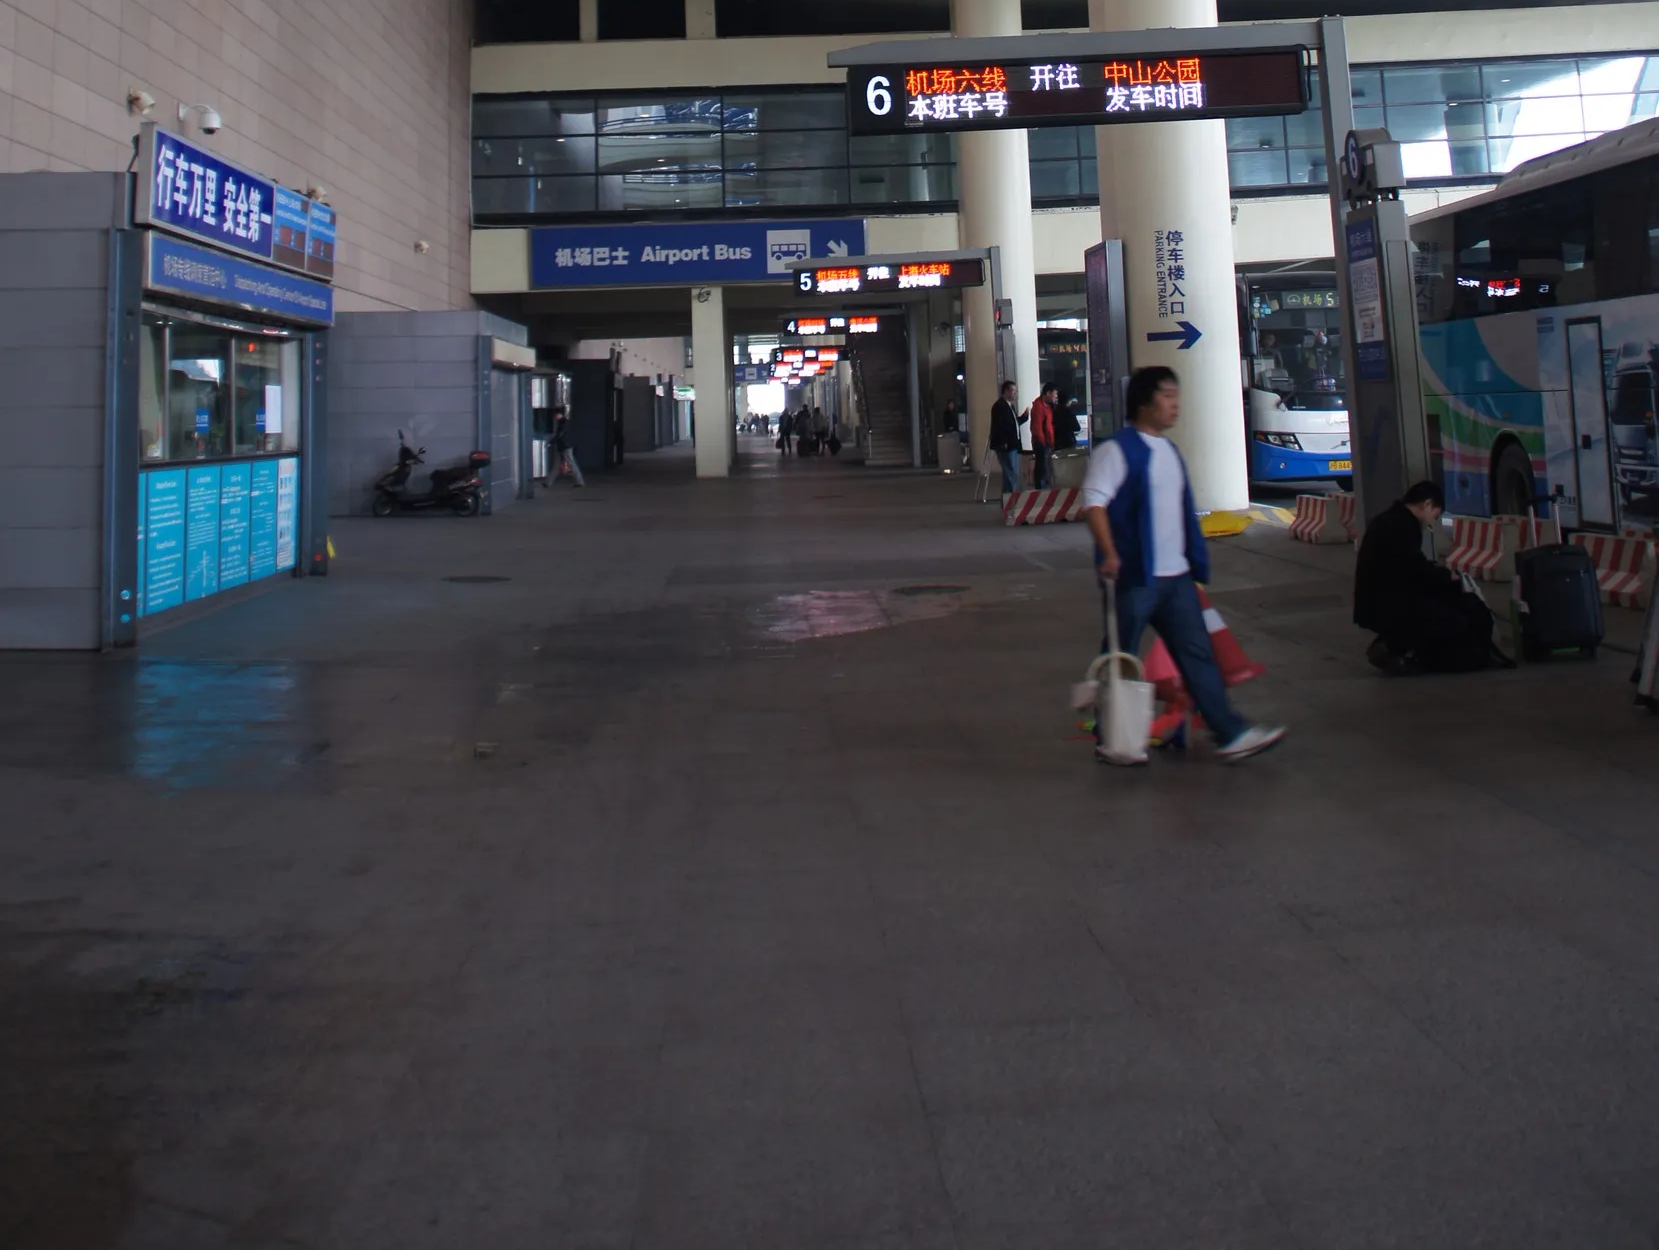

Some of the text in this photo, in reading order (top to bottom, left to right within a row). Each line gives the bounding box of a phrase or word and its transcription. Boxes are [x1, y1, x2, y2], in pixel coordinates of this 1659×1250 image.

[865, 75, 892, 116] 6
[905, 57, 1201, 96] 机场六线 开往 中山公园
[907, 81, 1204, 120] 本班车号 发车时间
[1348, 137, 1358, 179] 6
[156, 145, 272, 243] 行车万里 安全第一
[554, 243, 752, 268] 机场巴士 Airport Bus
[1154, 230, 1169, 319] PARKING ENTRANCE
[1165, 230, 1186, 316] 停车楼入口
[800, 272, 812, 291] 5
[787, 320, 795, 333] 4
